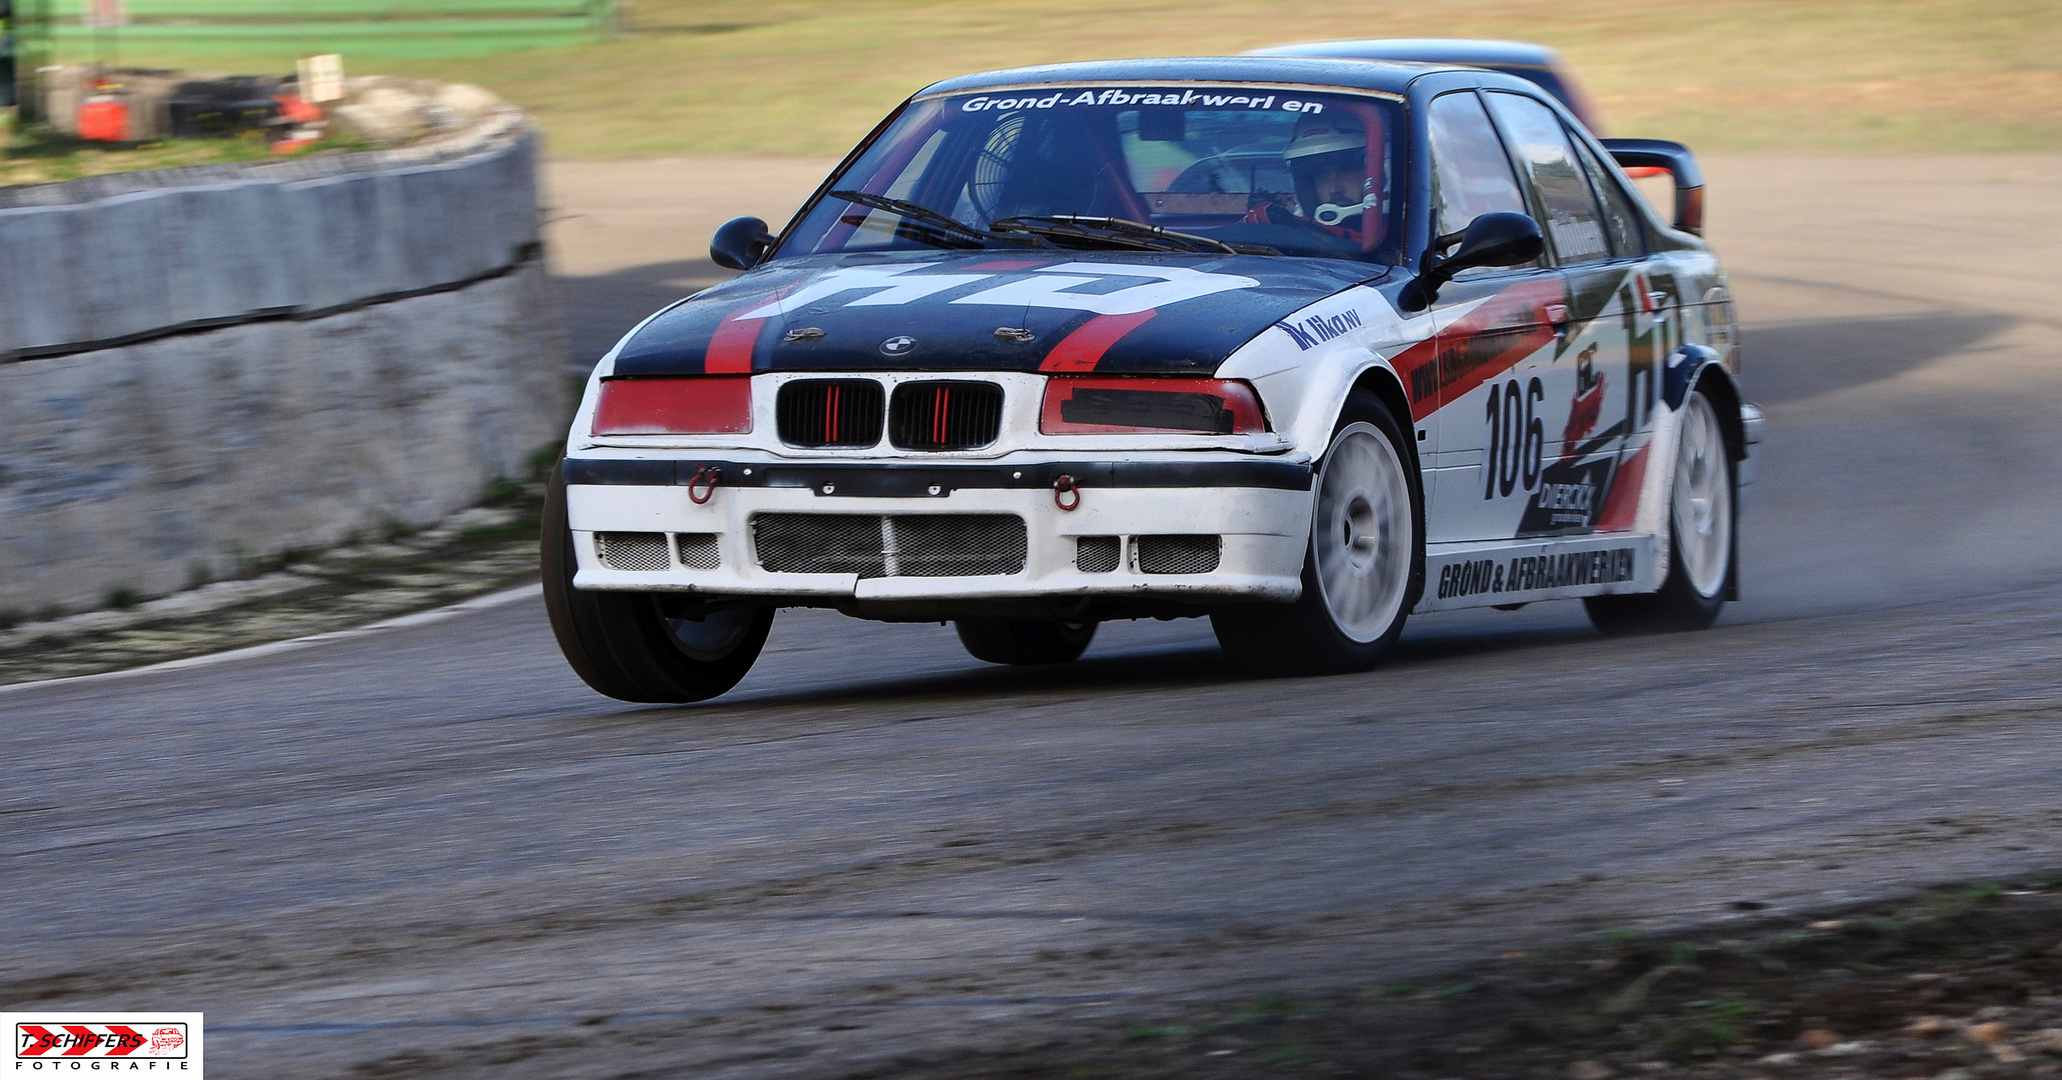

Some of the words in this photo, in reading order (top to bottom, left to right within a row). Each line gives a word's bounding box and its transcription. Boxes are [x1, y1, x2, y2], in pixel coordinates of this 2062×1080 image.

[1305, 314, 1348, 342] lika
[1341, 308, 1362, 330] NV
[1485, 376, 1544, 501] 106
[1437, 559, 1494, 600] GROND
[1491, 563, 1504, 593] &
